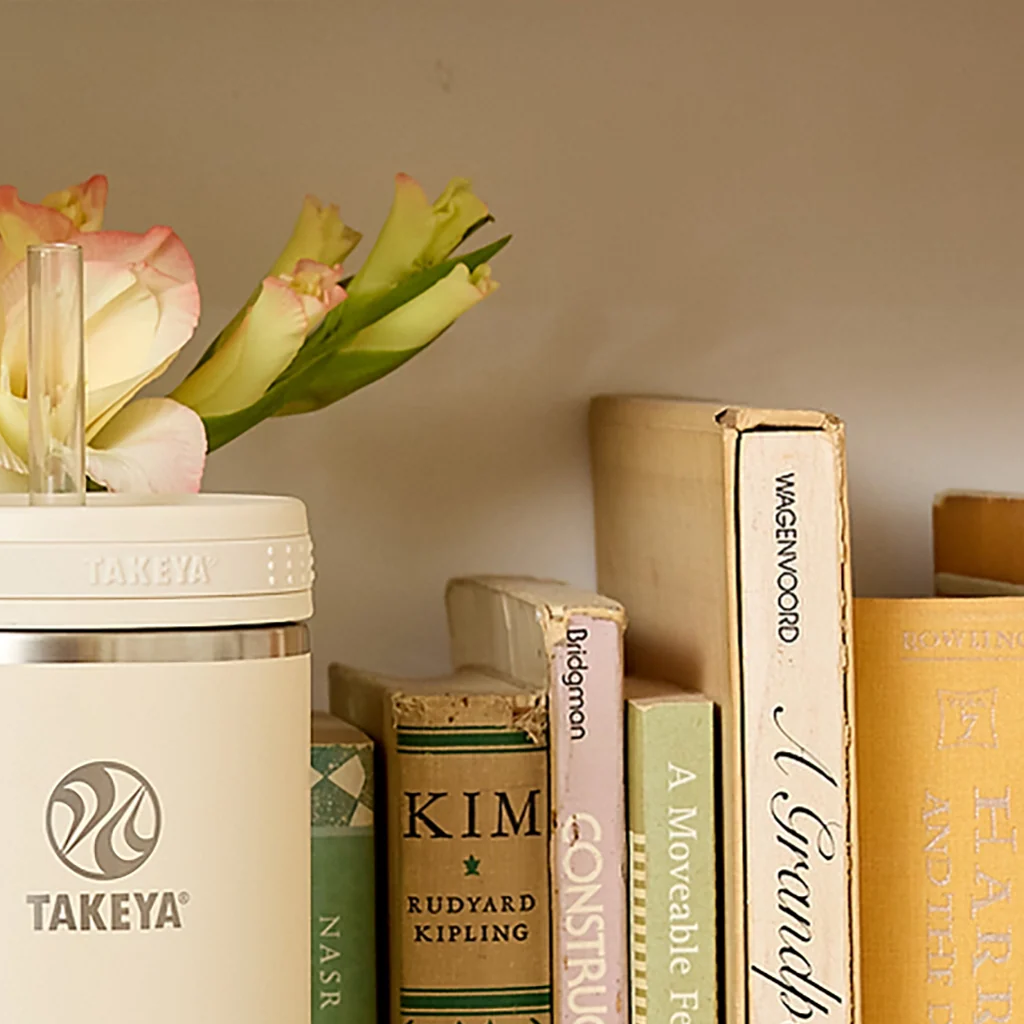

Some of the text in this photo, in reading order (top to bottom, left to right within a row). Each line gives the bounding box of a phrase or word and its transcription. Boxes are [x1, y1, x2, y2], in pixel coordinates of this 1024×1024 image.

[775, 472, 800, 643] WAGENVOORD
[561, 628, 589, 740] Bridgman
[667, 761, 697, 792] A
[773, 705, 839, 788] A
[403, 788, 542, 839] KIM
[921, 787, 952, 887] AND
[407, 893, 536, 914] RUDYARD
[414, 924, 530, 942] KIPLING
[667, 807, 700, 975] Moveable
[318, 915, 341, 1010] NASR
[927, 892, 957, 987] THE
